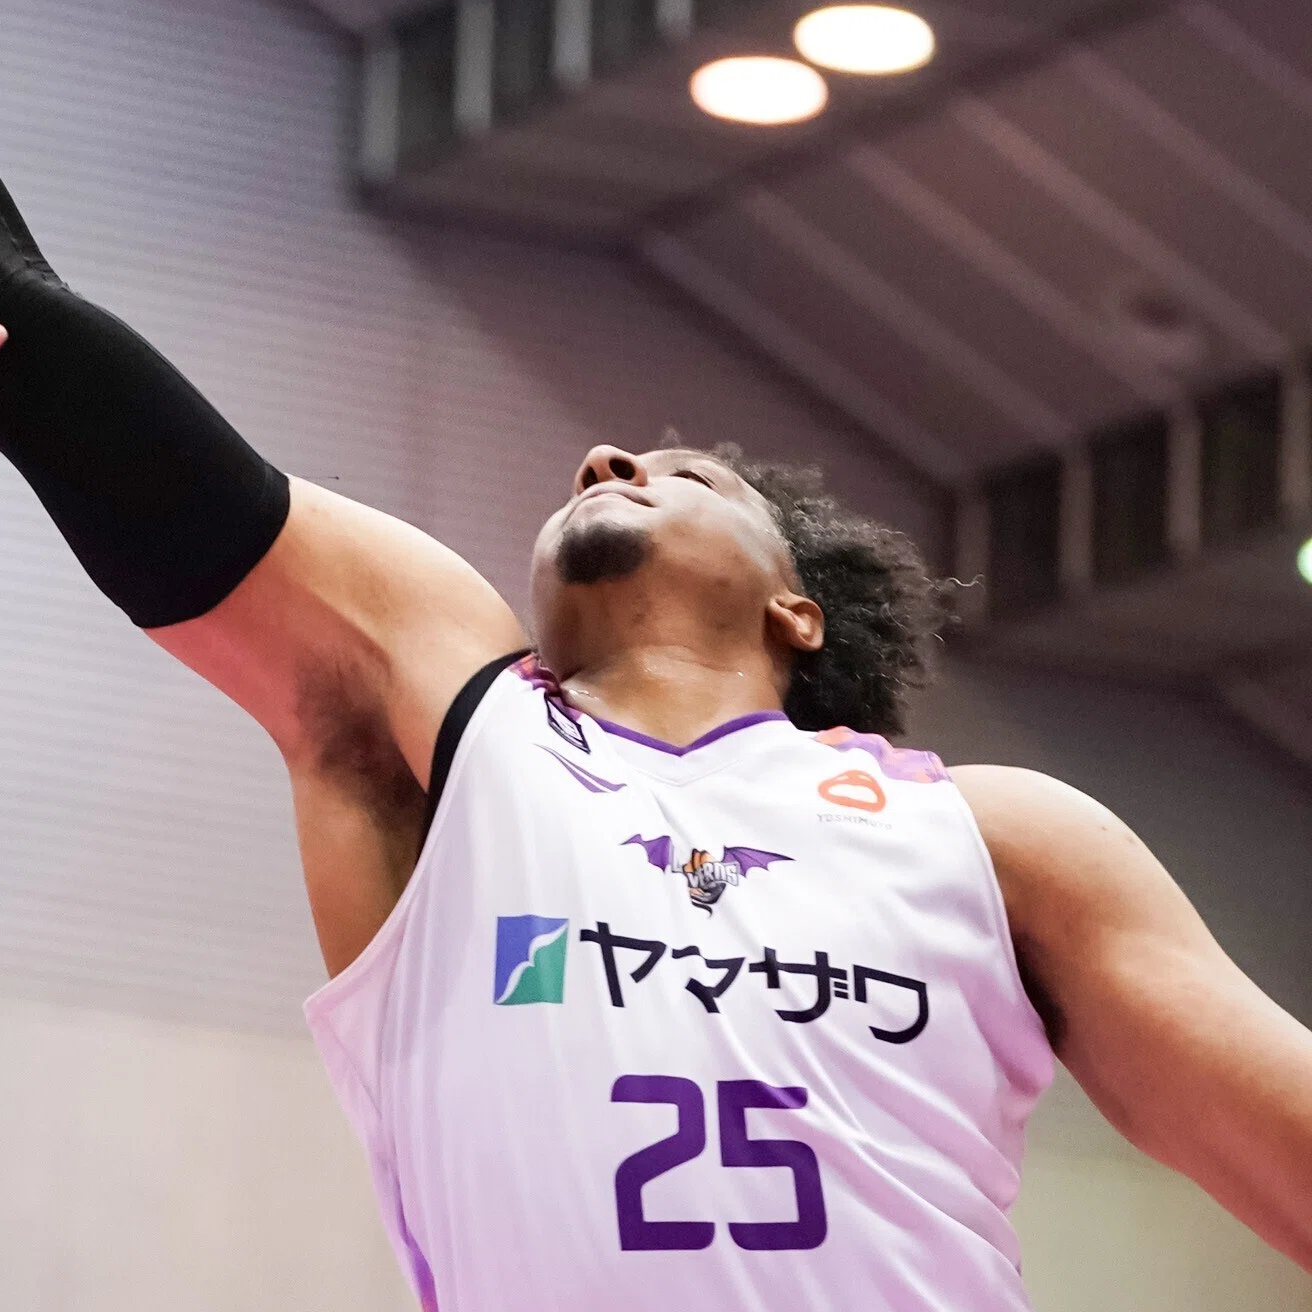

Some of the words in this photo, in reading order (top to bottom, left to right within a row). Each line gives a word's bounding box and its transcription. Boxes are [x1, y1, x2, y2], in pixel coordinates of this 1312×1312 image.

[580, 921, 929, 1045] ヤマザワ
[611, 1074, 827, 1251] 25
